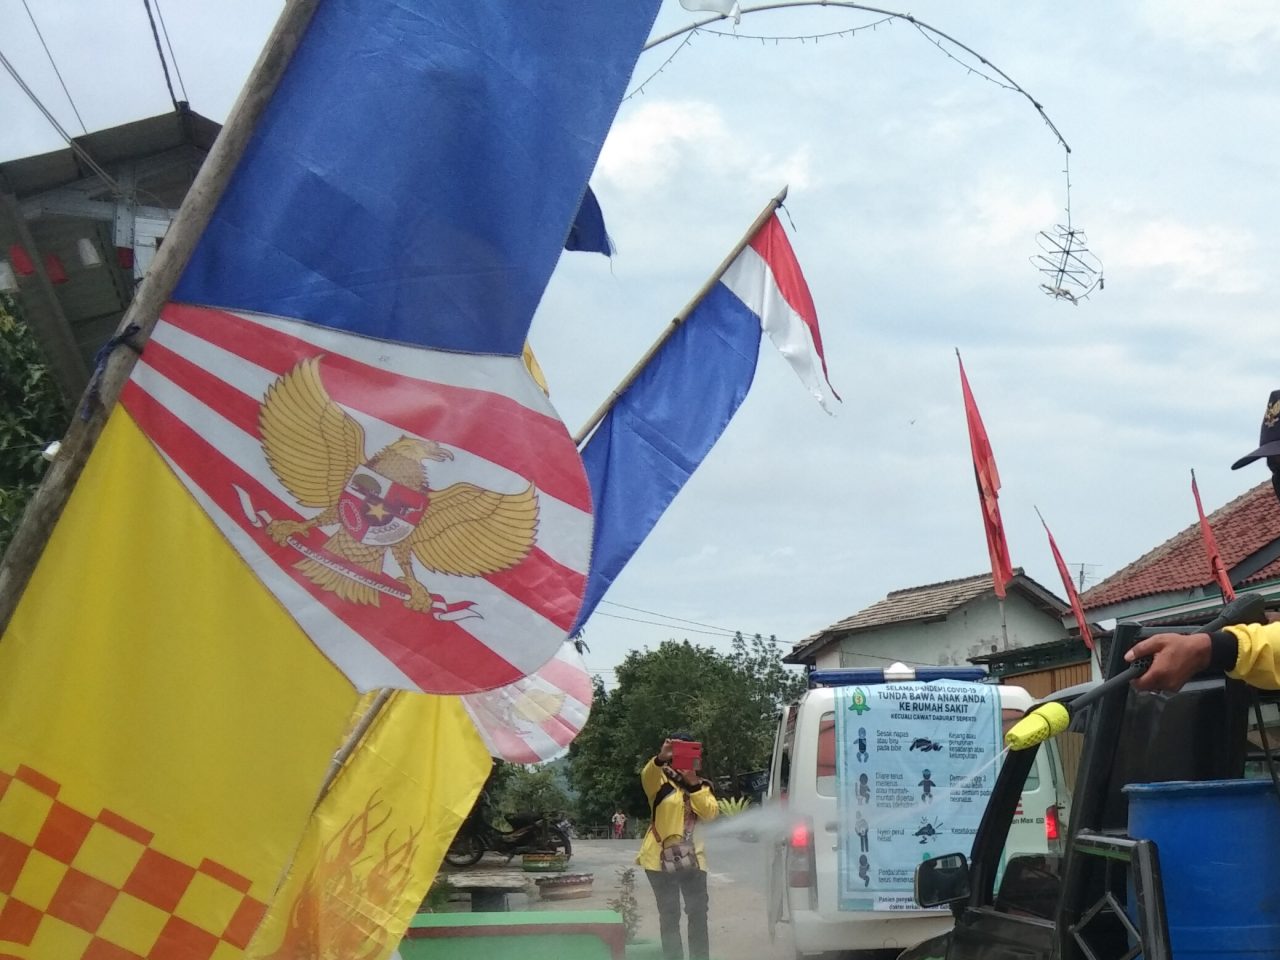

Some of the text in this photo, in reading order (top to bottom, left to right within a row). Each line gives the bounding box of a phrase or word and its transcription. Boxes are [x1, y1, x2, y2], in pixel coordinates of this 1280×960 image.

[878, 691, 986, 704] TUNDA BAWA ANAK ANDA
[899, 702, 968, 714] KE RUMAH SAKIT
